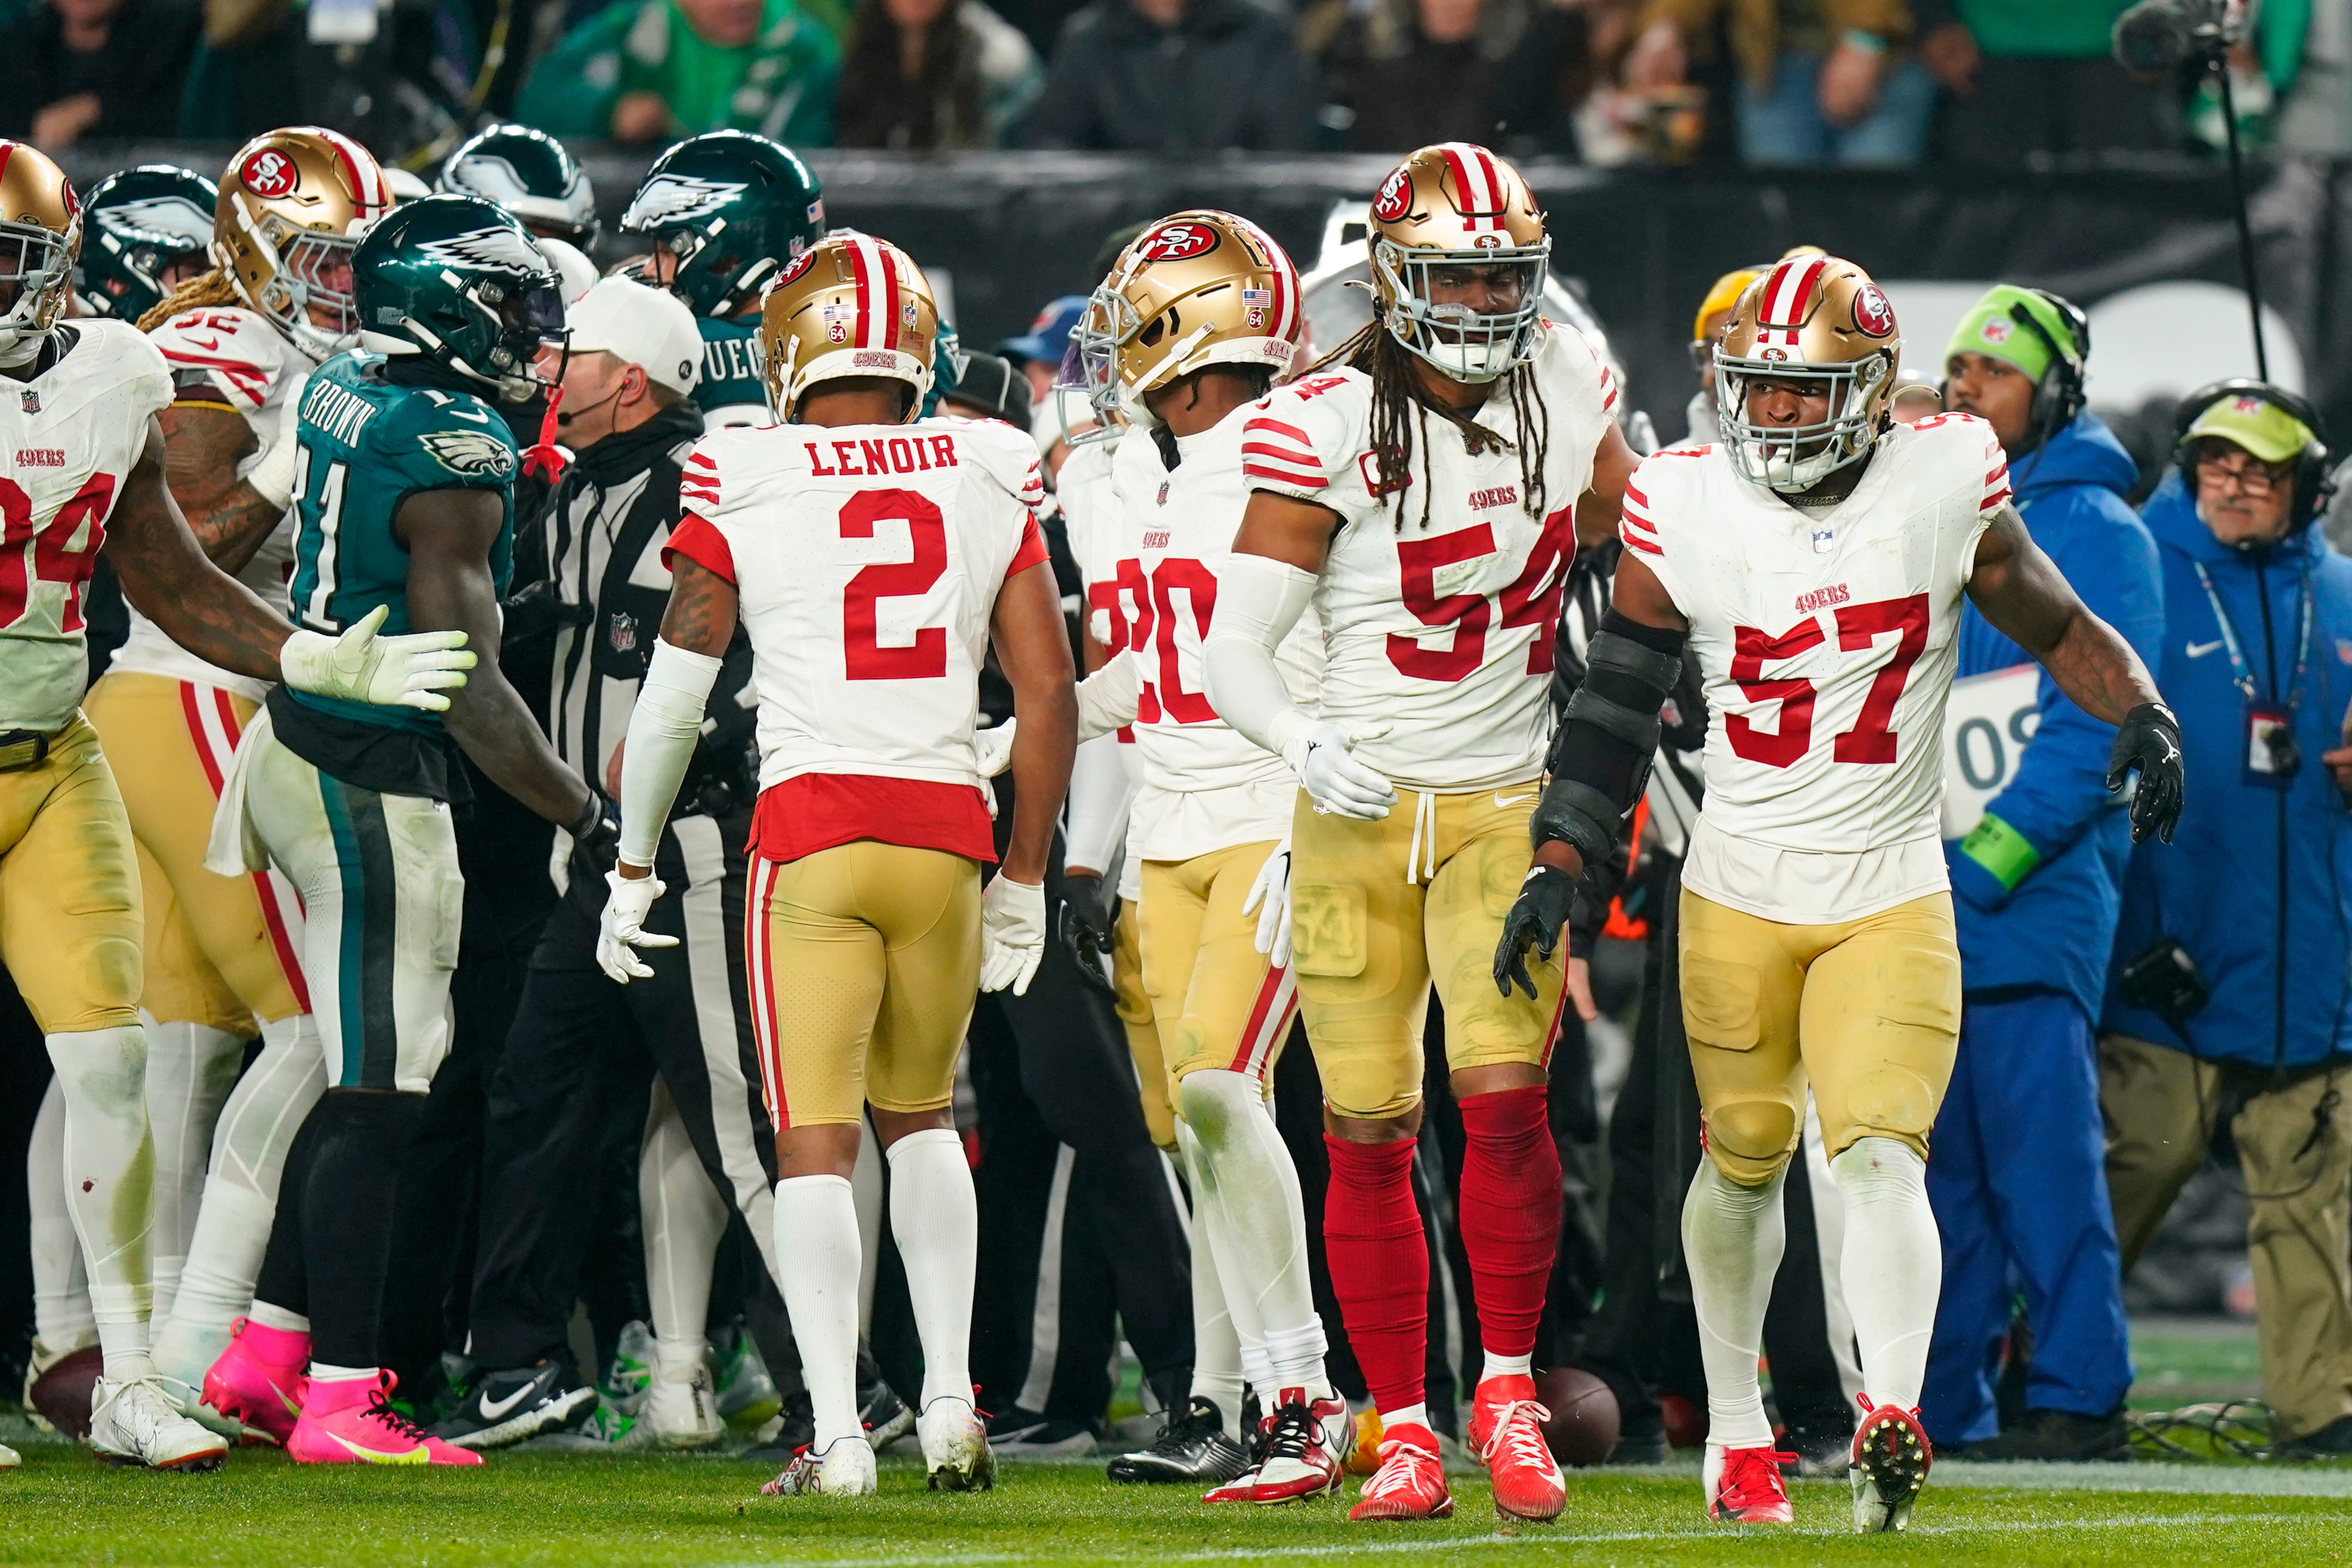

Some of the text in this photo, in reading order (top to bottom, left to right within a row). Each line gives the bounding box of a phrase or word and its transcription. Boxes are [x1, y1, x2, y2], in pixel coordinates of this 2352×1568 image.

[1156, 226, 1204, 256] SF
[829, 329, 845, 340] 64
[1249, 313, 1263, 325] 64
[852, 351, 897, 368] 49ERS
[302, 379, 376, 449] BROWN
[16, 449, 65, 467] 49ERS
[804, 434, 958, 477] LENOIR
[1468, 485, 1517, 511] 49ERS
[839, 488, 947, 680] 2
[1385, 504, 1575, 682] 54
[1795, 582, 1850, 614] 49ERS
[1725, 593, 1930, 768] 57
